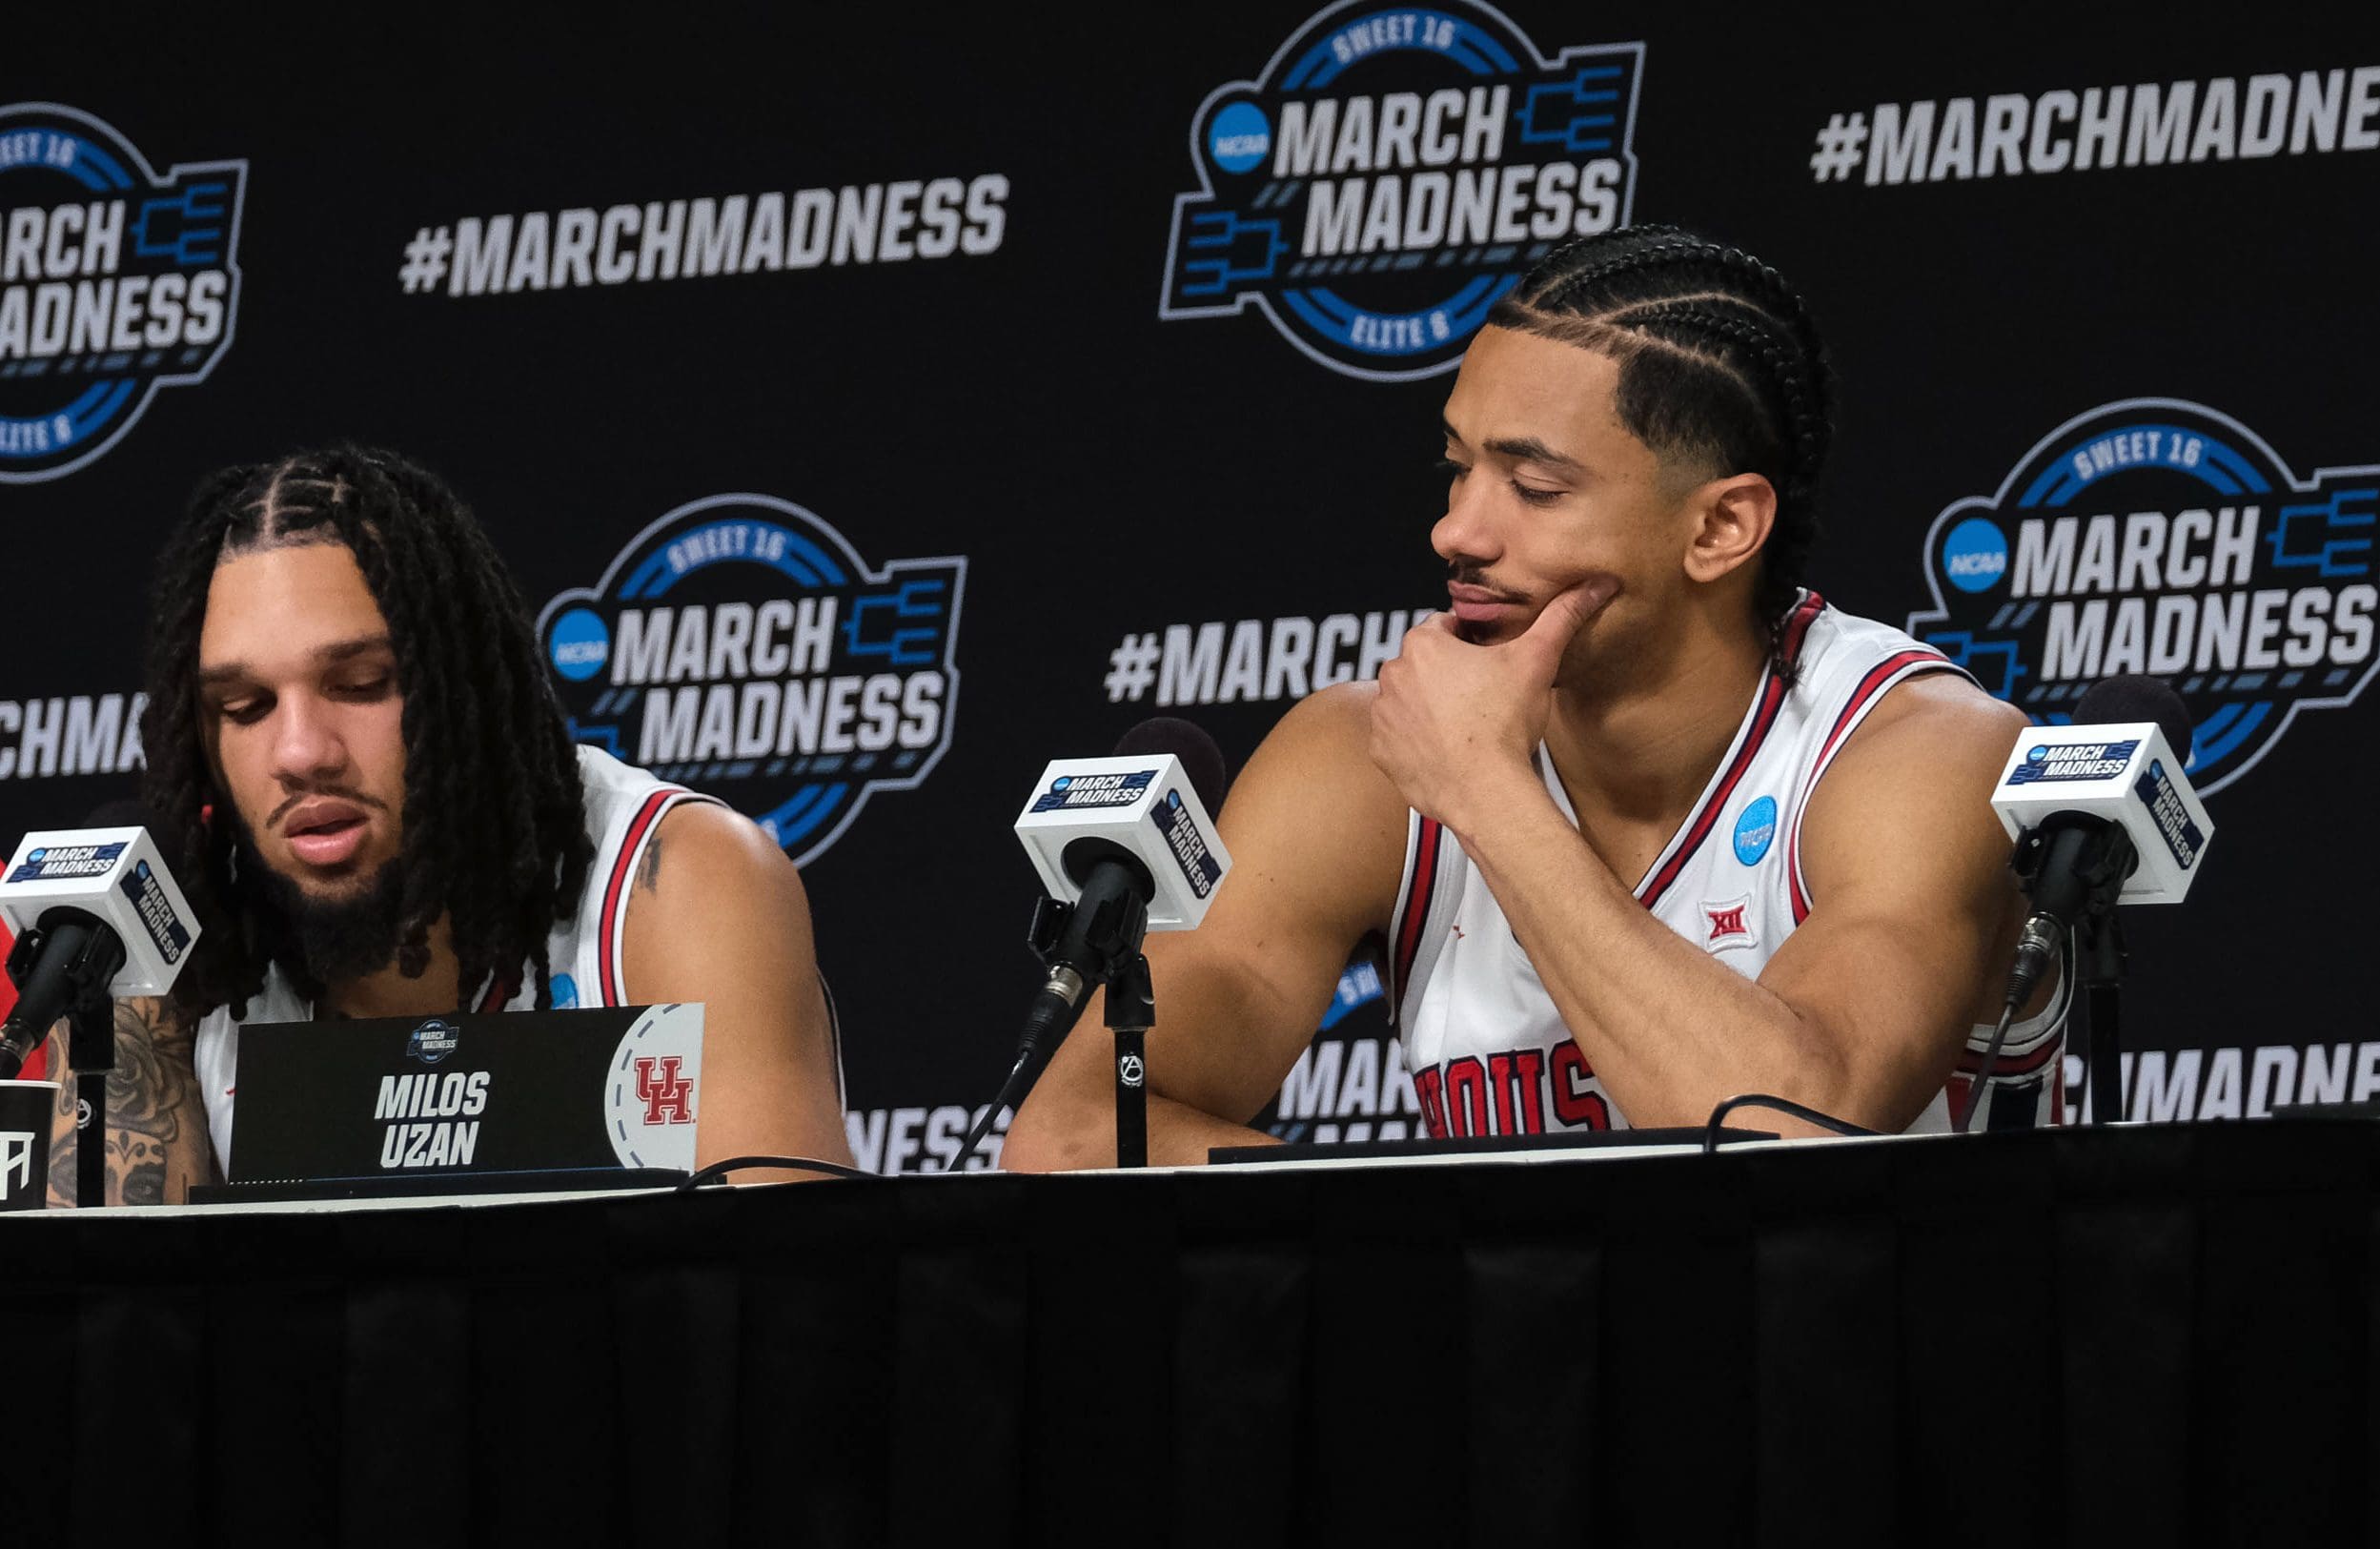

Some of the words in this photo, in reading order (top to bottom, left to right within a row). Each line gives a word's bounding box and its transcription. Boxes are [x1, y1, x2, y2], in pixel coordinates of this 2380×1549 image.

[1332, 14, 1416, 64] SWEET
[1422, 15, 1454, 46] 16
[1272, 84, 1511, 178] MARCH
[398, 173, 1009, 297] #MARCHMADNESS
[1300, 158, 1620, 257] MADNESS
[2073, 431, 2162, 480] SWEET
[2168, 433, 2202, 468] 16
[1949, 552, 2007, 576] NCAA
[2010, 504, 2261, 598] MARCH
[609, 597, 838, 685] MARCH
[1103, 608, 1437, 707] #MARCH
[2041, 583, 2379, 682] MADNESS
[638, 670, 945, 764] MADNESS
[2043, 745, 2107, 762] MARCH
[2043, 759, 2128, 776] MADNESS
[1065, 787, 1145, 805] MADNESS
[1067, 775, 1126, 791] MARCH
[2156, 775, 2189, 830] MARCH
[41, 846, 99, 863] MARCH
[1173, 805, 1206, 860] MARCH
[2152, 795, 2193, 866] MADNESS
[39, 858, 116, 875] MADNESS
[1169, 825, 1210, 896] MADNESS
[137, 894, 180, 962] MADNESS
[142, 875, 175, 928] MARCH
[374, 1070, 491, 1119] MILOS
[634, 1055, 694, 1126] UH
[380, 1121, 480, 1169] UZAN
